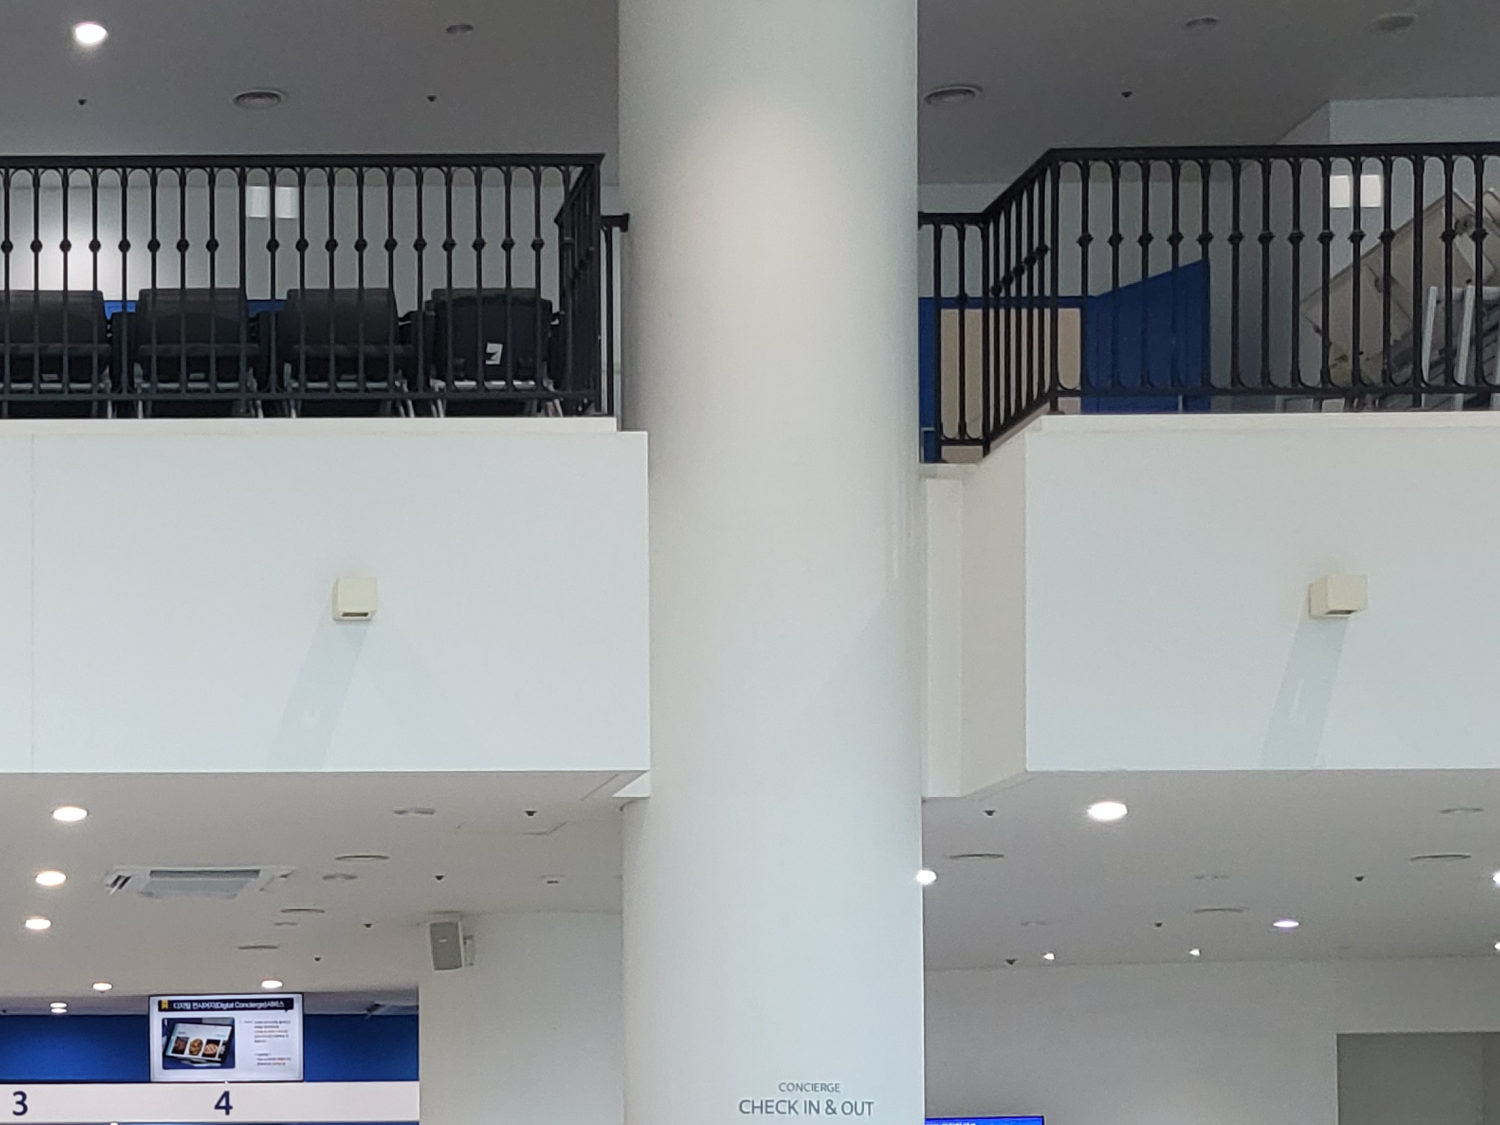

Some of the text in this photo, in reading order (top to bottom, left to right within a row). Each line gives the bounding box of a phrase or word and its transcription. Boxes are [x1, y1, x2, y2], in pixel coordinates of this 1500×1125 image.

[778, 1082, 841, 1093] CONCIERGE
[11, 1091, 28, 1116] 3
[214, 1091, 233, 1116] 4
[739, 1099, 875, 1116] CHECK IN & OUT
